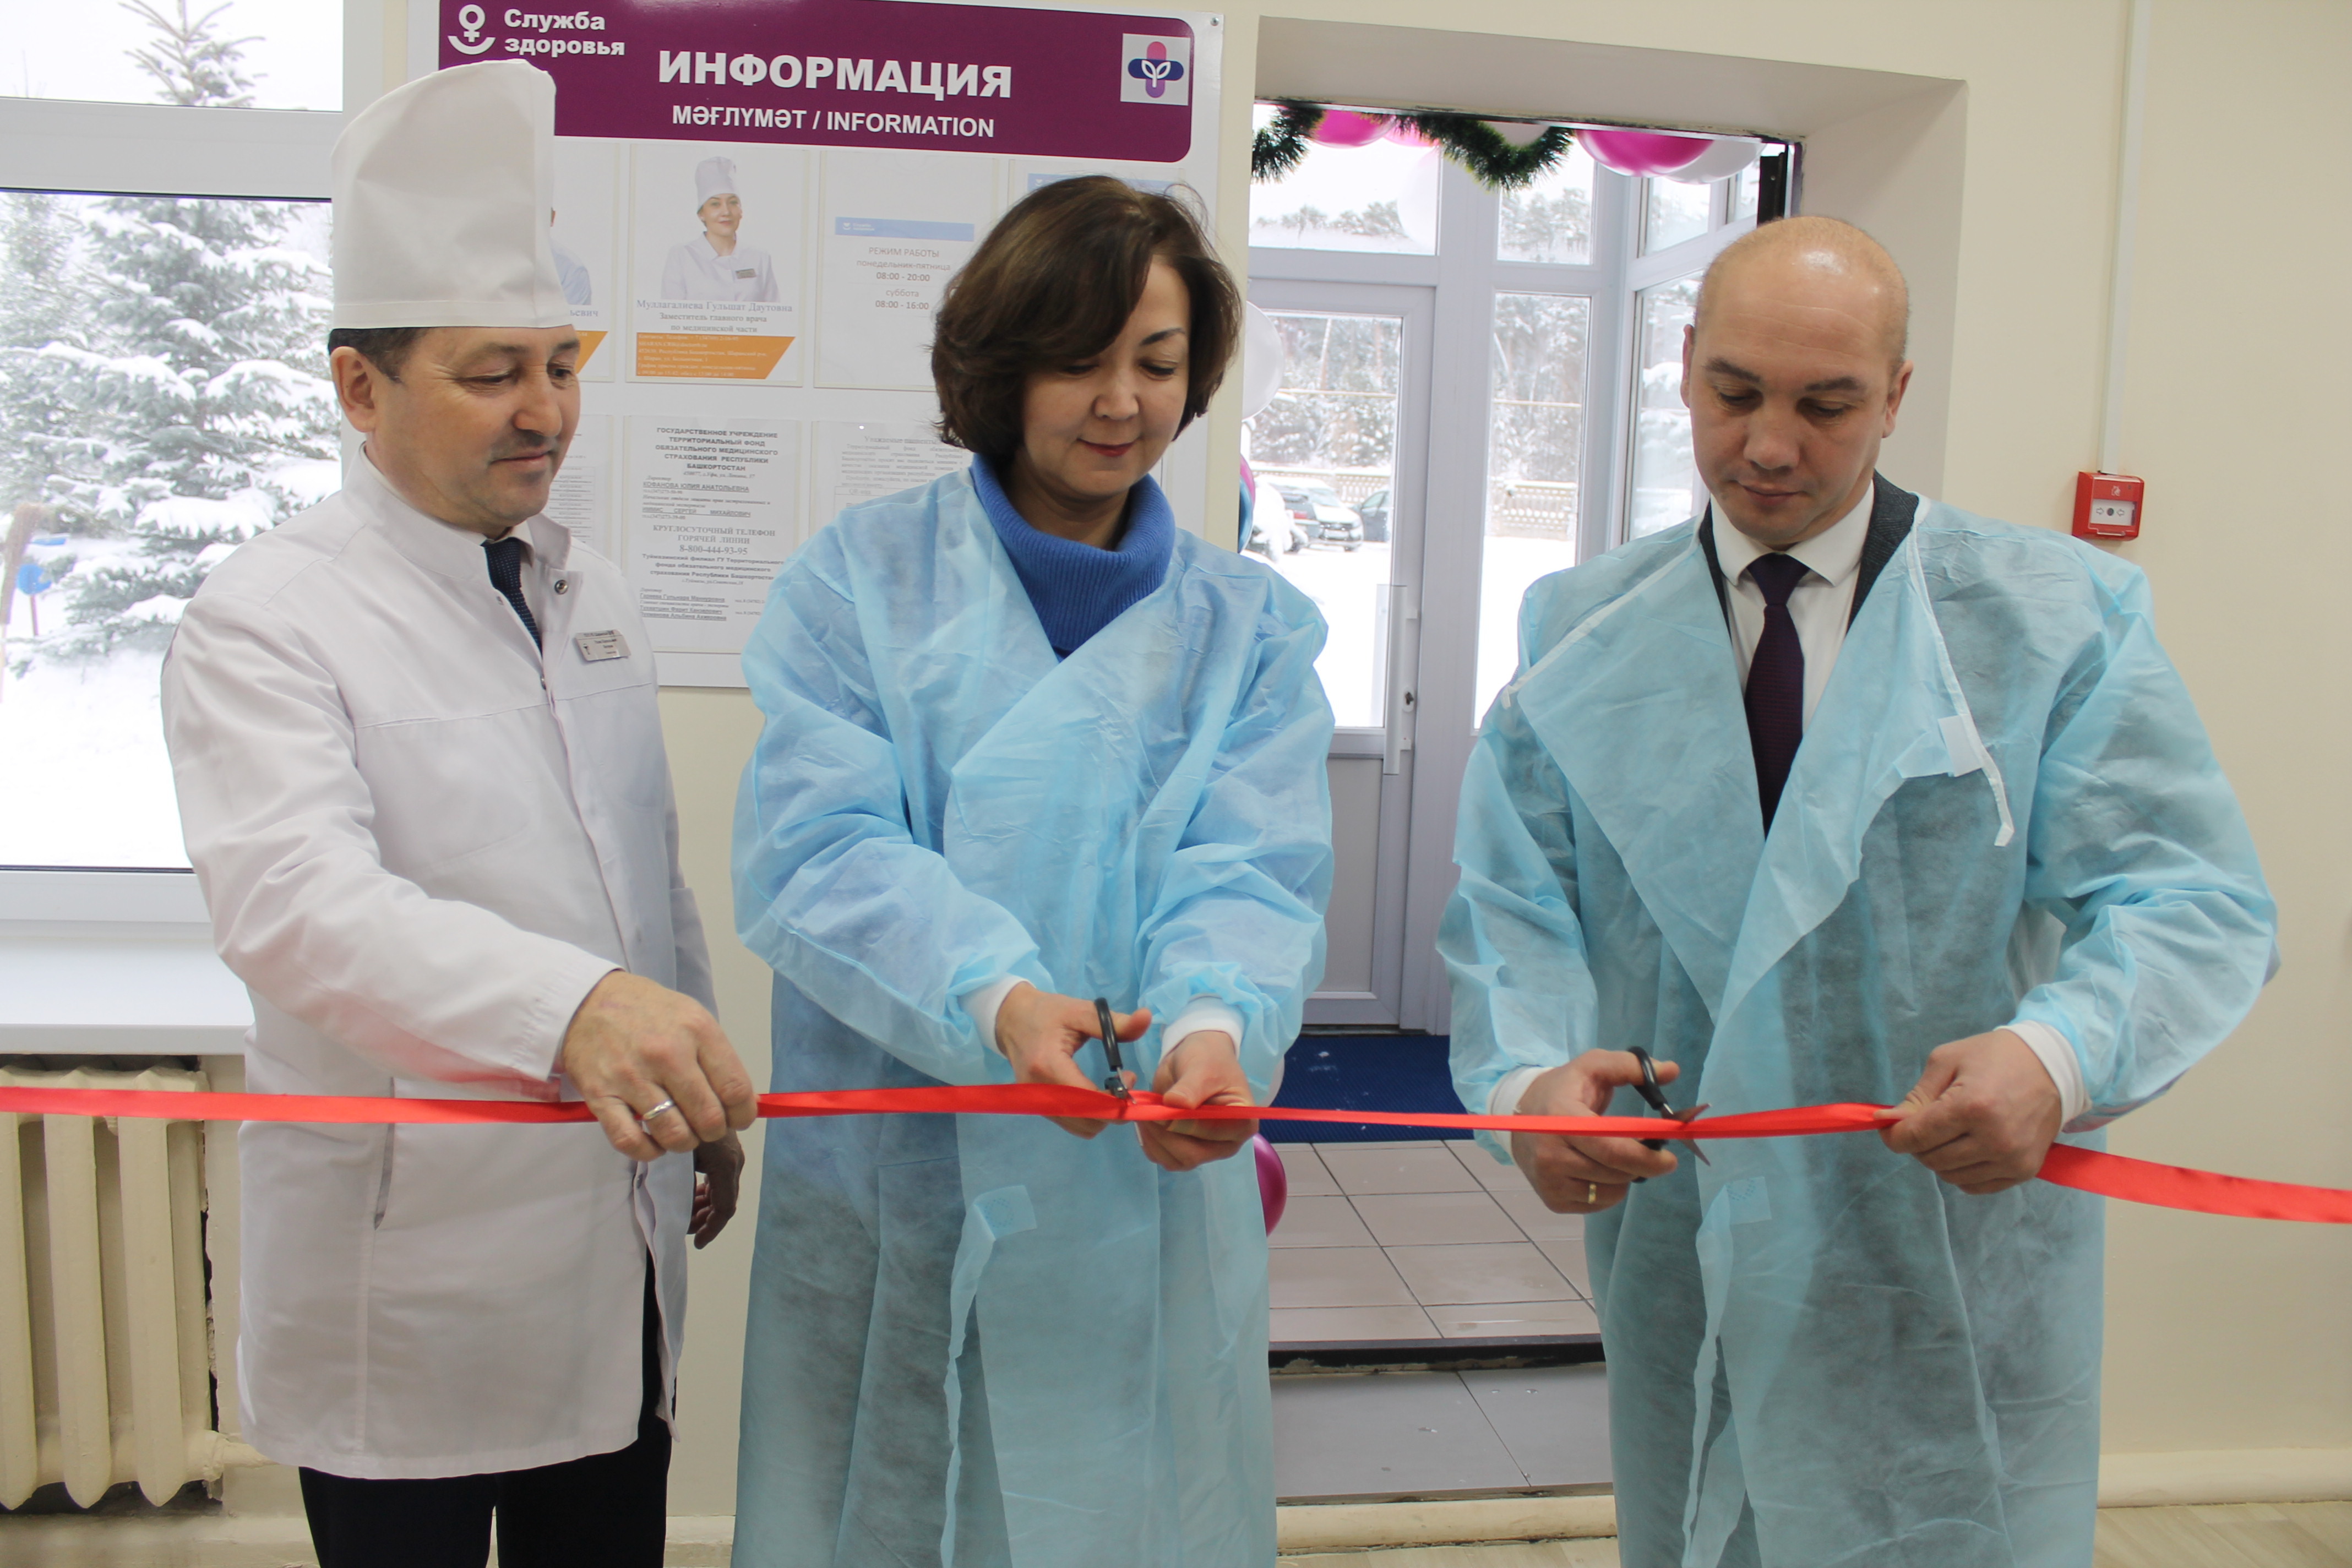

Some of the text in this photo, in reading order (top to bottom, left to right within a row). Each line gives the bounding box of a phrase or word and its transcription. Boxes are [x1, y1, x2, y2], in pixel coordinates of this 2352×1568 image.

[504, 8, 606, 32] Служба
[504, 36, 625, 58] здоровья
[658, 50, 1012, 101] ИНФОРМАЦИЯ
[812, 111, 820, 129] /
[827, 112, 994, 138] INFORMATION
[868, 247, 940, 258] РЕЖИМ РАБОТЫ
[856, 260, 951, 271] понедельник-пятница
[876, 272, 900, 280] 08:00
[907, 274, 930, 282] 20:00
[886, 289, 919, 297] суббота
[706, 302, 746, 312] Гульшат
[748, 302, 793, 313] Даутовна
[875, 300, 899, 308] 08:00
[906, 302, 929, 310] 16:00
[656, 427, 727, 436] ГОСУДАРСТВЕННОЕ
[669, 437, 742, 445] ТЕРРИТОРИАЛЬНЫЙ
[718, 448, 778, 456] МЕДИЦИНСКОГО
[687, 463, 746, 471] БАШКОРТОСТАН
[653, 525, 776, 537] КРУГЛОСУТОЧНЫЙ ТЕЛЕФОН
[678, 534, 716, 543] ГОРЯЧЕЙ
[679, 545, 748, 555] 8-800-444-93-95
